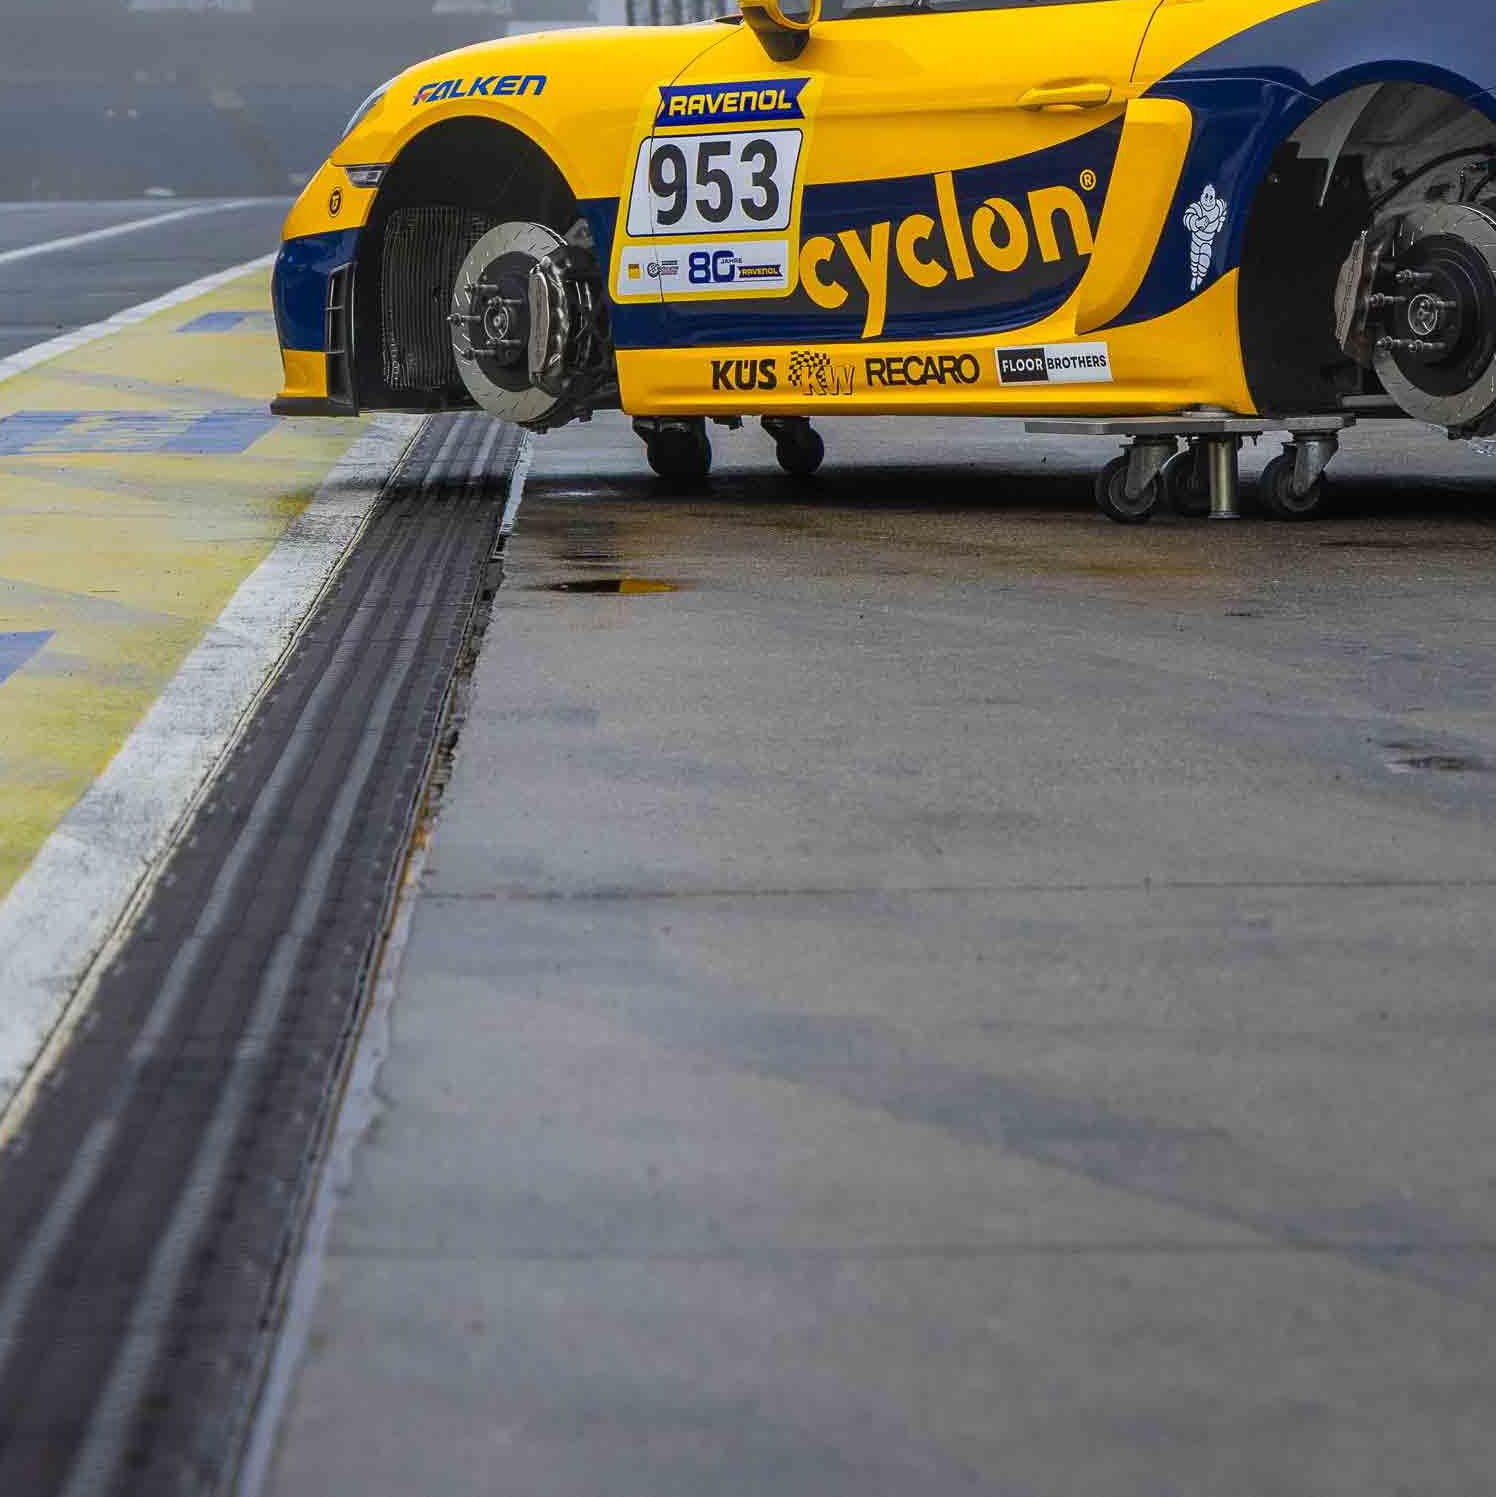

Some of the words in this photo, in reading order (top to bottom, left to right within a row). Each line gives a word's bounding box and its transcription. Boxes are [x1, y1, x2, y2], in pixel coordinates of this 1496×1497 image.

[413, 74, 546, 105] FALKEN
[668, 89, 794, 117] RAVENOL
[650, 138, 780, 227] 953
[688, 250, 735, 284] 80
[720, 257, 743, 265] JAHRE
[742, 267, 779, 277] RAVENOL
[710, 358, 778, 391] KÜS
[865, 353, 980, 387] RECARO
[1002, 357, 1044, 374] FLOOR
[1046, 354, 1107, 370] BROTHERS
